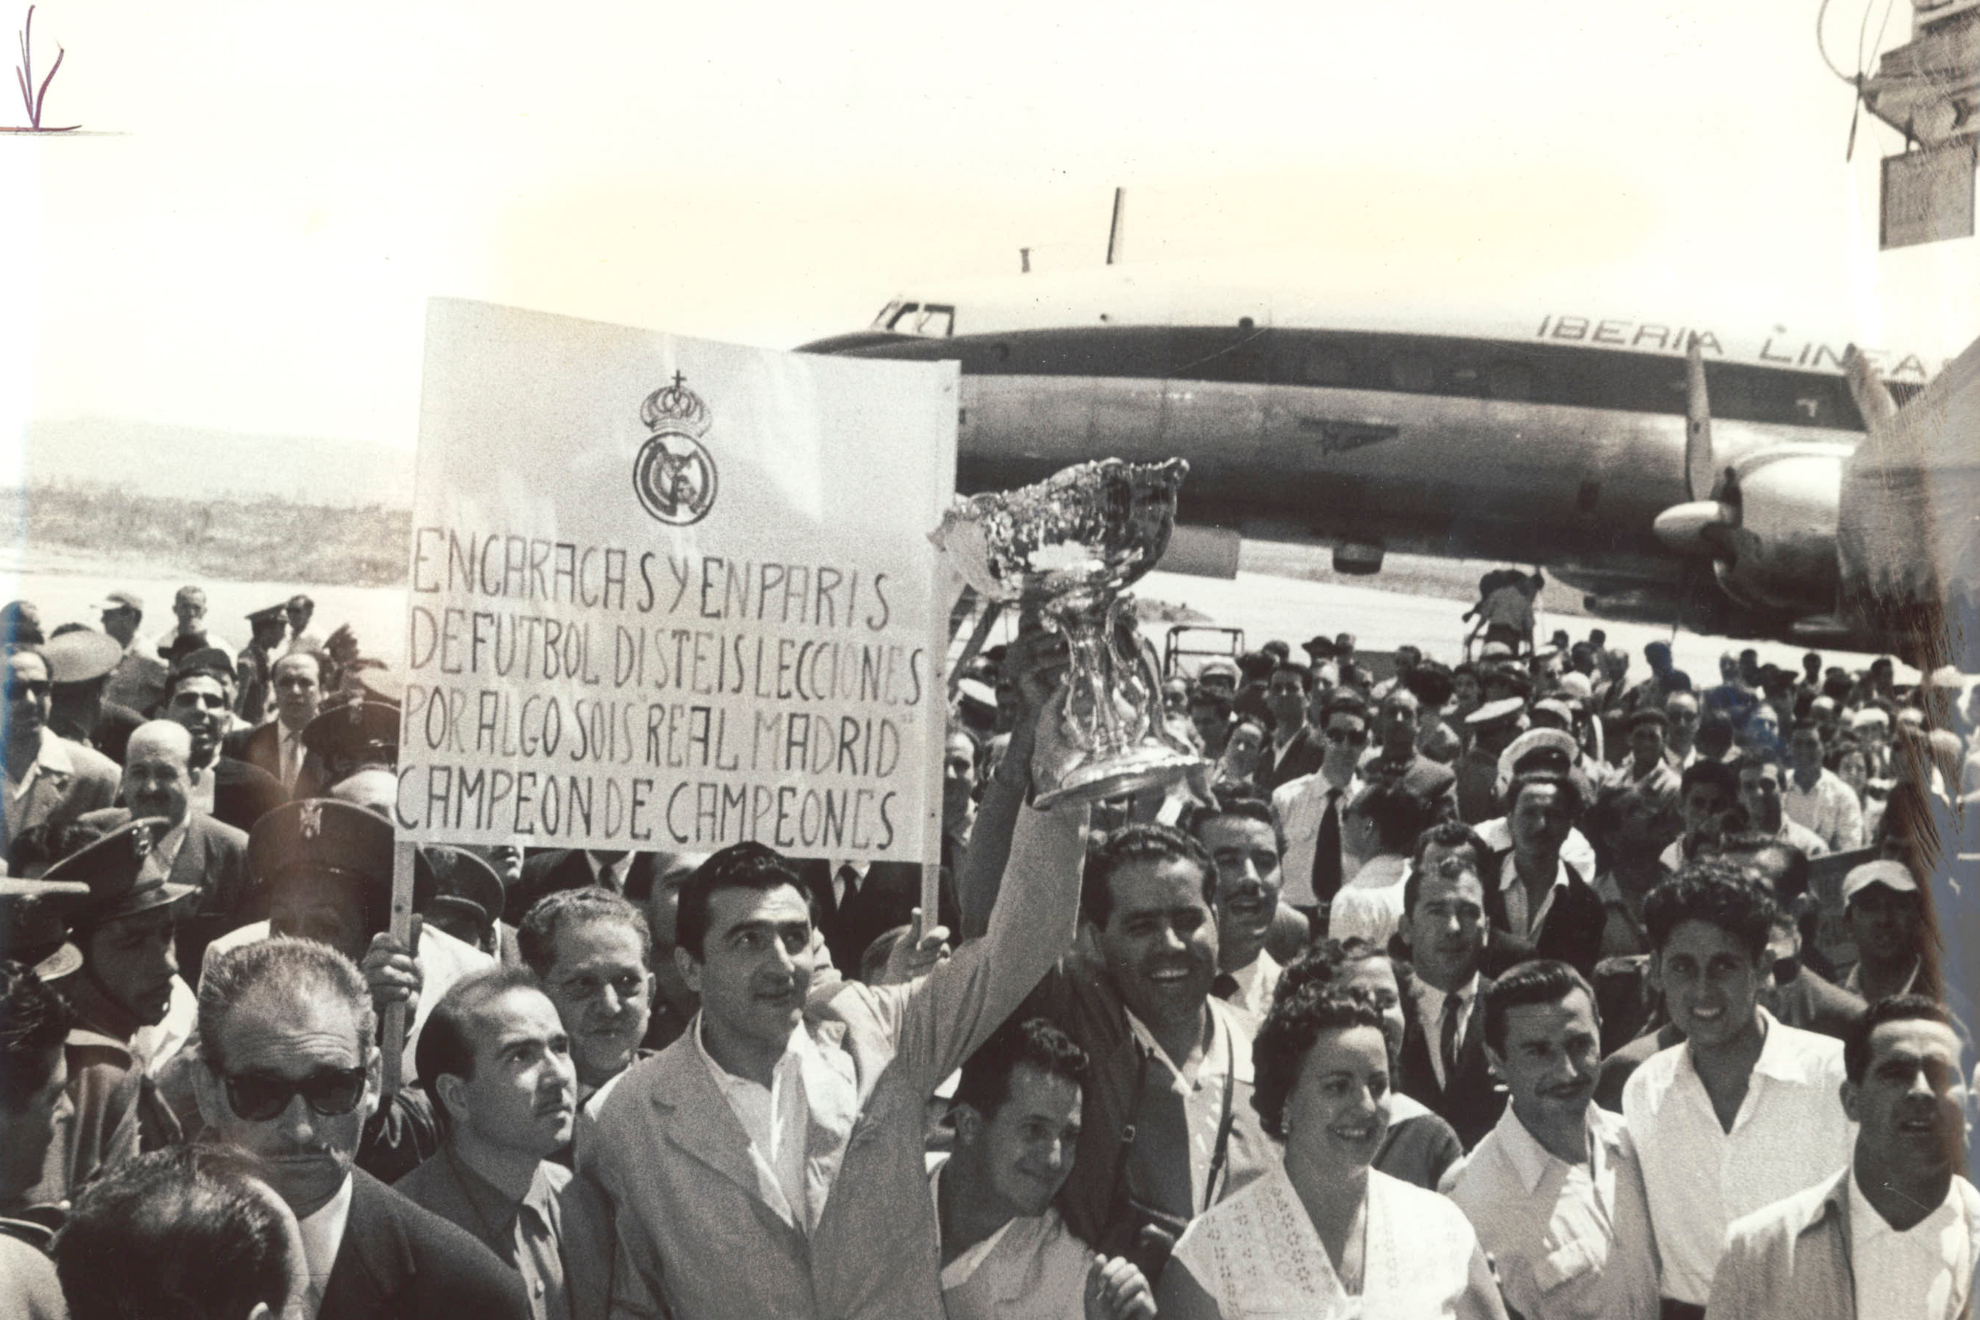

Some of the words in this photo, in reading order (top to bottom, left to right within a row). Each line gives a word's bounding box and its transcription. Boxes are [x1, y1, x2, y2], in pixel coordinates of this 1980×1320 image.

[1537, 315, 1724, 355] IBERIA
[413, 527, 476, 594] EN
[480, 533, 656, 613] CARACAS
[668, 555, 689, 615] Y
[700, 556, 750, 619] EN
[757, 562, 890, 631] PARIS
[410, 605, 465, 674] DE
[471, 611, 600, 685] FUTBOL
[614, 624, 744, 695] DISTEIS
[755, 636, 924, 706] LECCIONES
[403, 684, 467, 753] POR
[476, 689, 561, 757] ALGO
[570, 699, 635, 764] SOIS
[647, 703, 739, 771] REAL
[751, 709, 901, 778] MADRID
[395, 764, 592, 837] CAMPEON
[604, 777, 654, 840] DE
[666, 780, 896, 850] CAMPEONES
